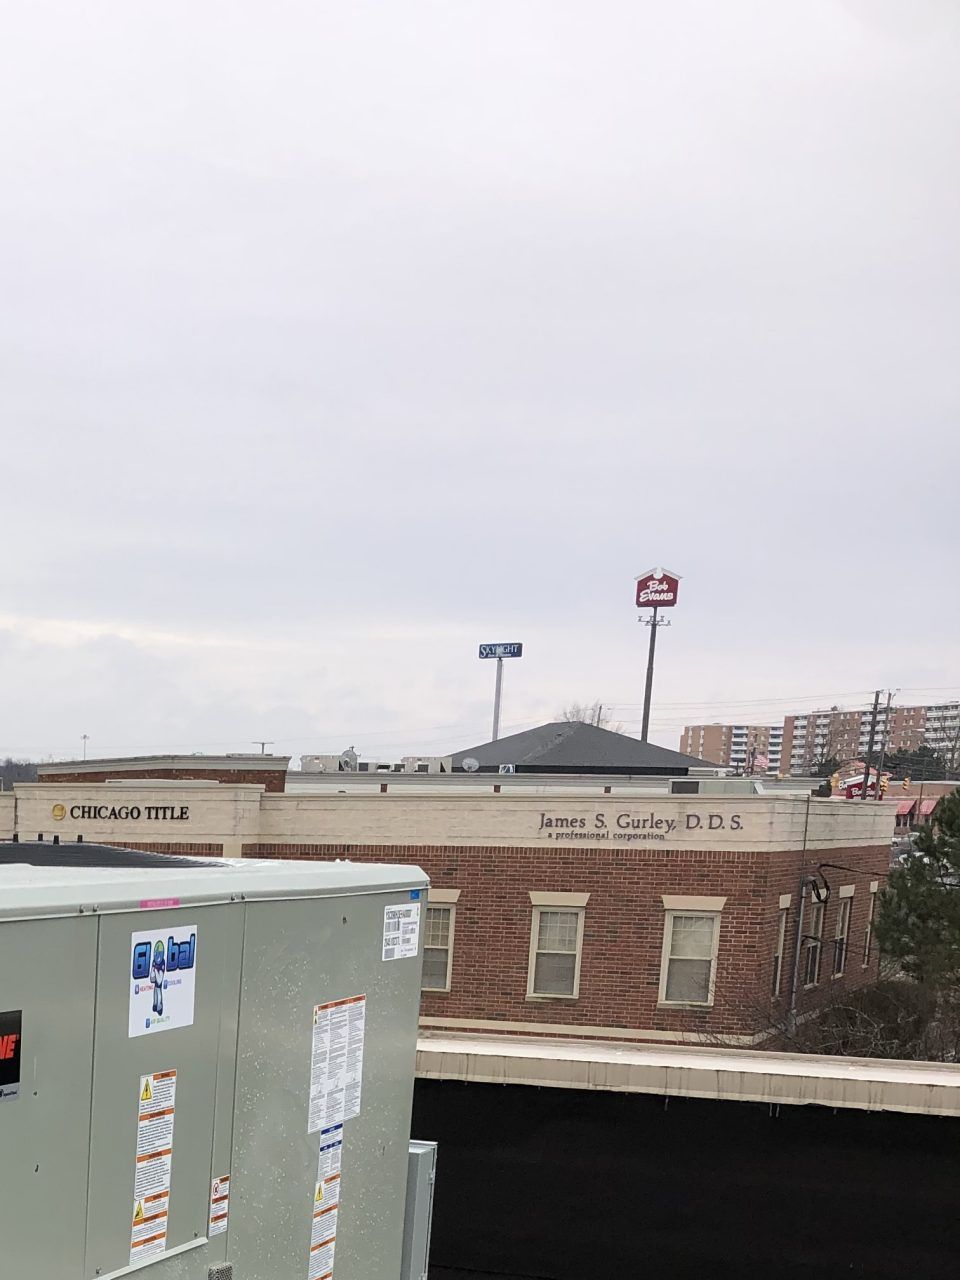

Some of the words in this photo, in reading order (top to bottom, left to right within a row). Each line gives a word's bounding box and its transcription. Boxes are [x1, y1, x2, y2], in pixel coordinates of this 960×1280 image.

[646, 580, 669, 592] Bob
[639, 589, 674, 603] Evans
[70, 805, 141, 820] CHICAGO
[144, 806, 190, 820] TITLE
[539, 812, 586, 830] James
[594, 813, 608, 829] S.
[616, 812, 677, 834] Gurley,
[555, 830, 609, 841] professional
[613, 832, 665, 841] corporation
